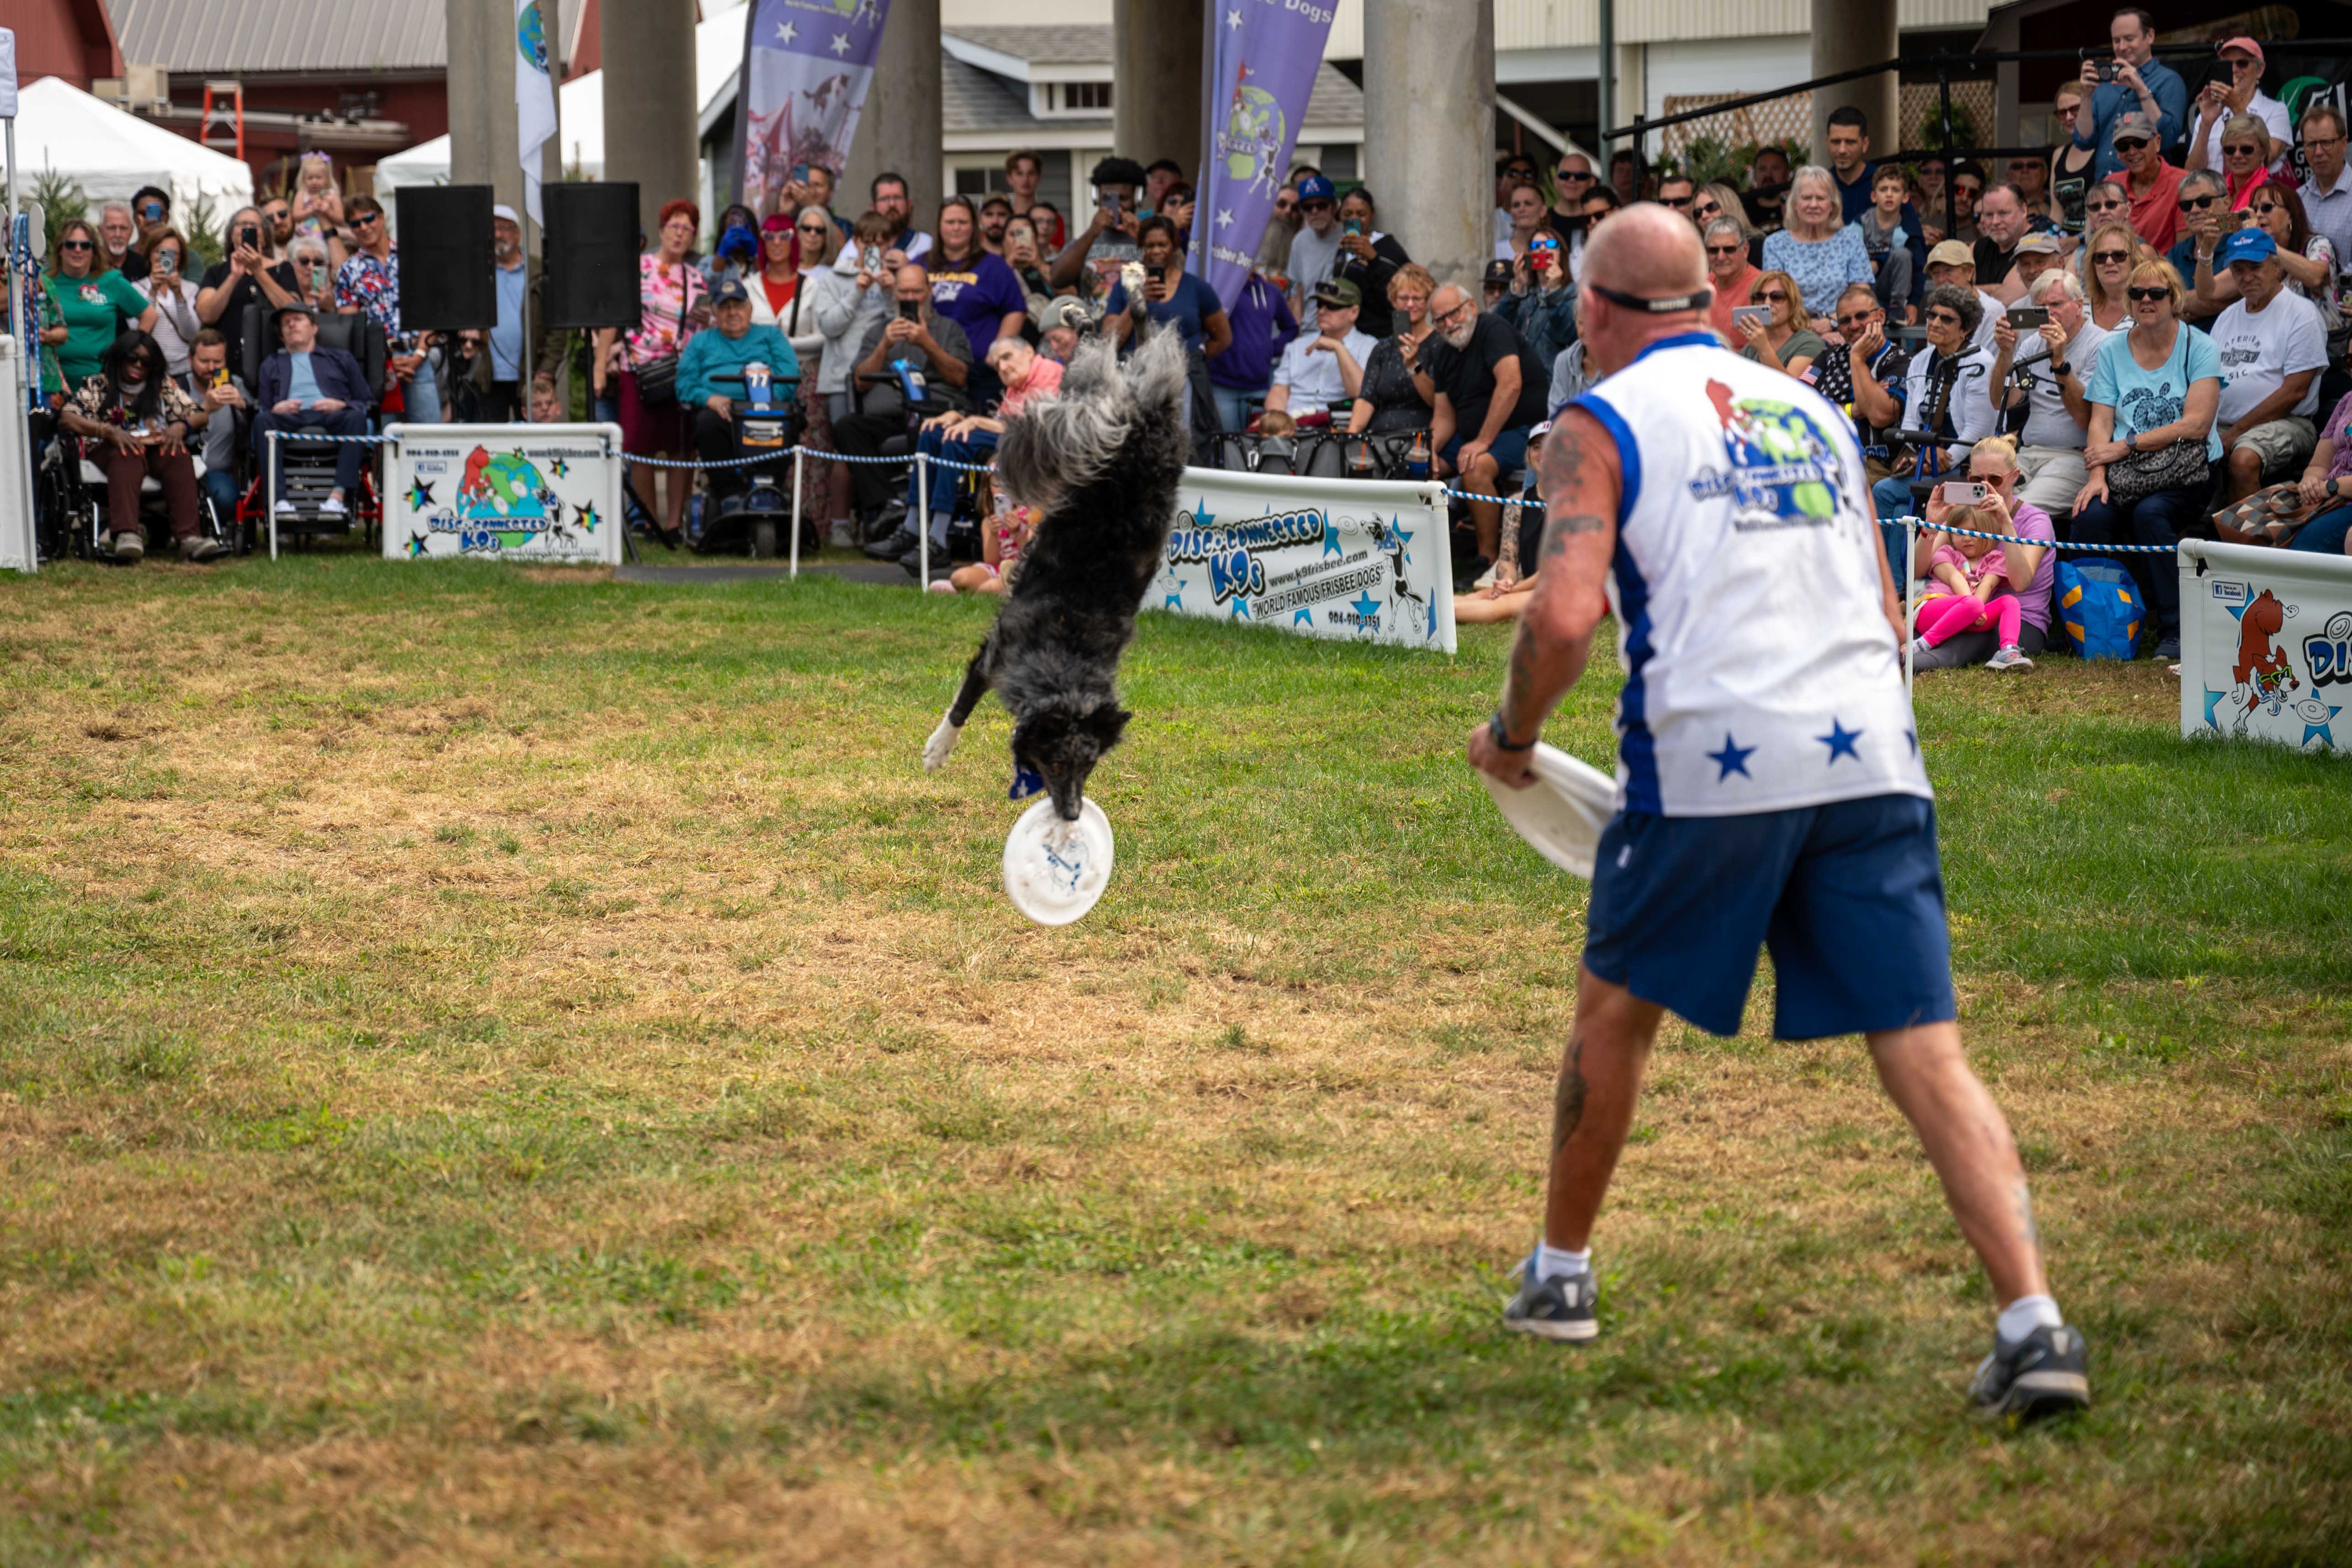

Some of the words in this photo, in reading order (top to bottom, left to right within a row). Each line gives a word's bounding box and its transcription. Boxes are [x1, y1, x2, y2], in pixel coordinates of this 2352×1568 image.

[1284, 0, 1332, 23] Dogs
[1210, 549, 1262, 599] K9s
[1268, 550, 1368, 587] www.k9frisbee.com
[1286, 586, 1321, 609] FAMOUS
[1321, 573, 1357, 598] FRISBEE
[1328, 610, 1381, 628] 904-910-1351
[2308, 640, 2352, 676] DI
